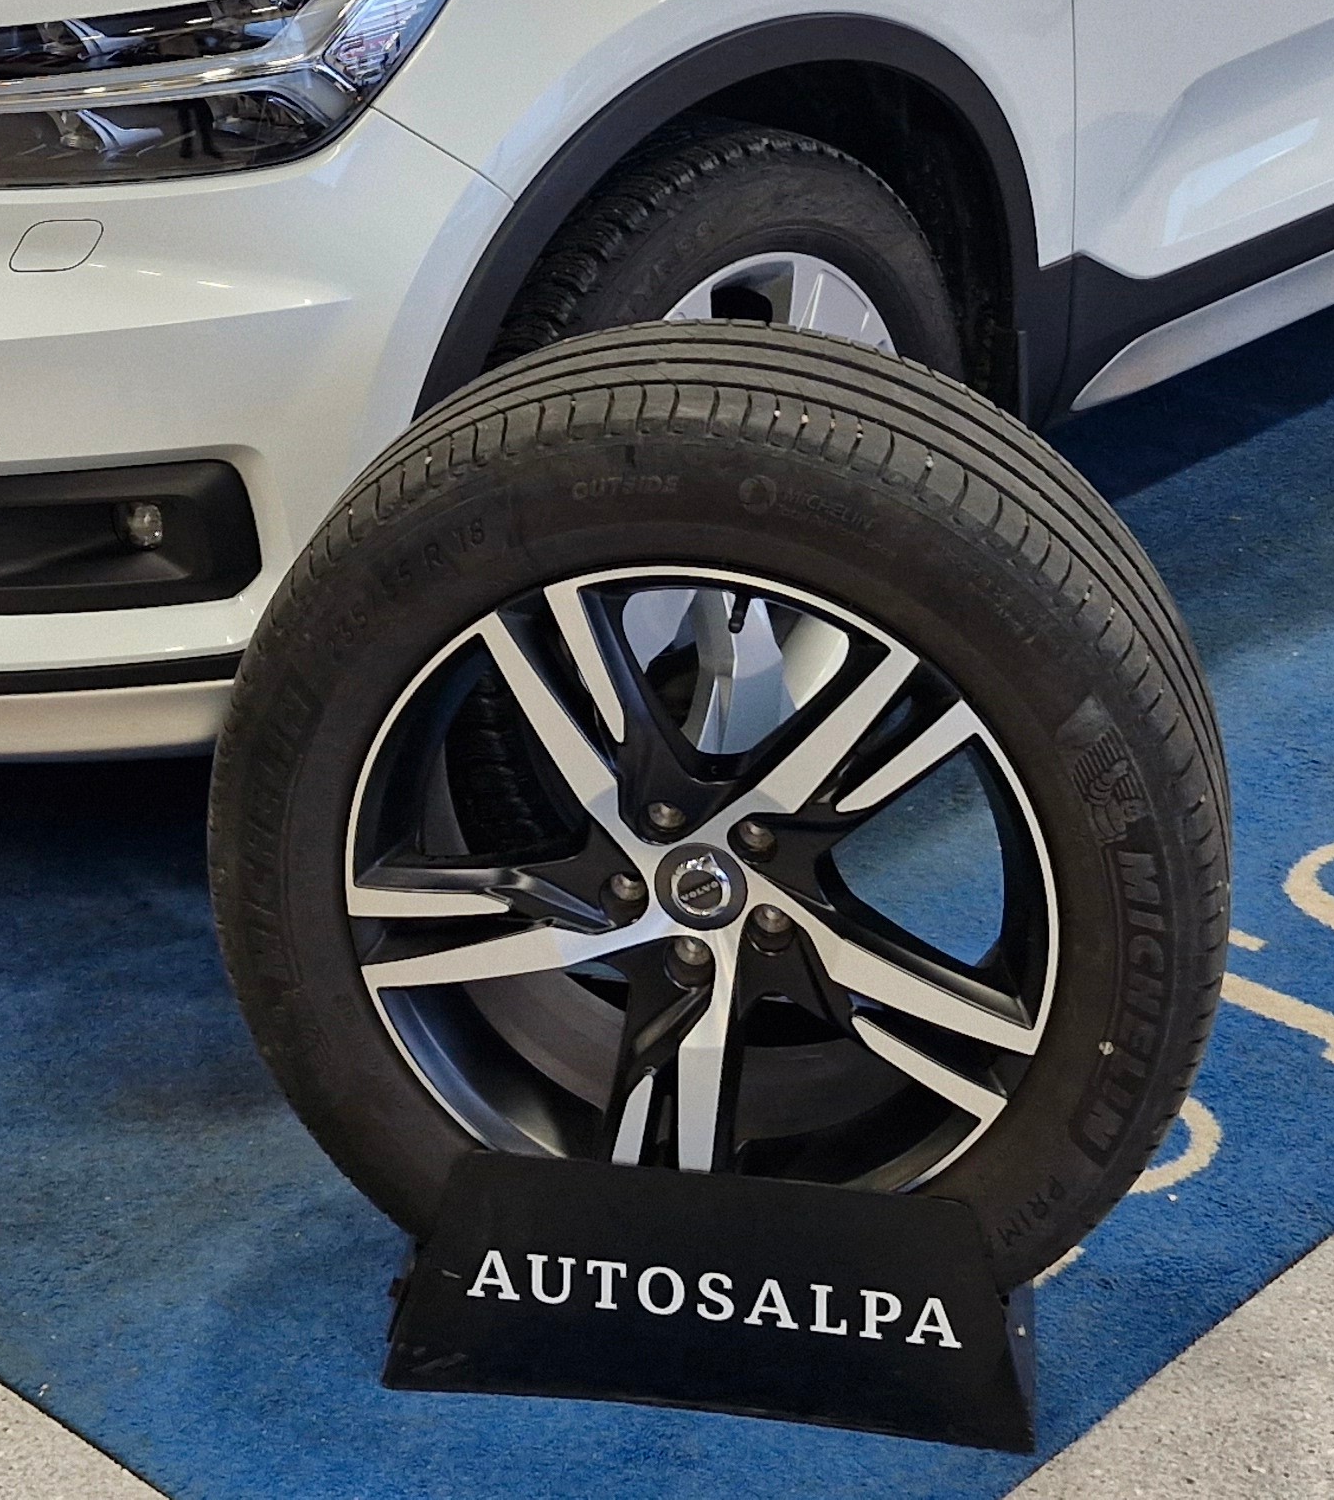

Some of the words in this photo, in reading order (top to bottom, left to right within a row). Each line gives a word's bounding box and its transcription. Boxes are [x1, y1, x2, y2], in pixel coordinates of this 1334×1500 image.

[679, 880, 720, 902] VOLVO
[1081, 849, 1166, 1154] MICHELIN
[466, 1248, 964, 1350] AUTOSALPA
